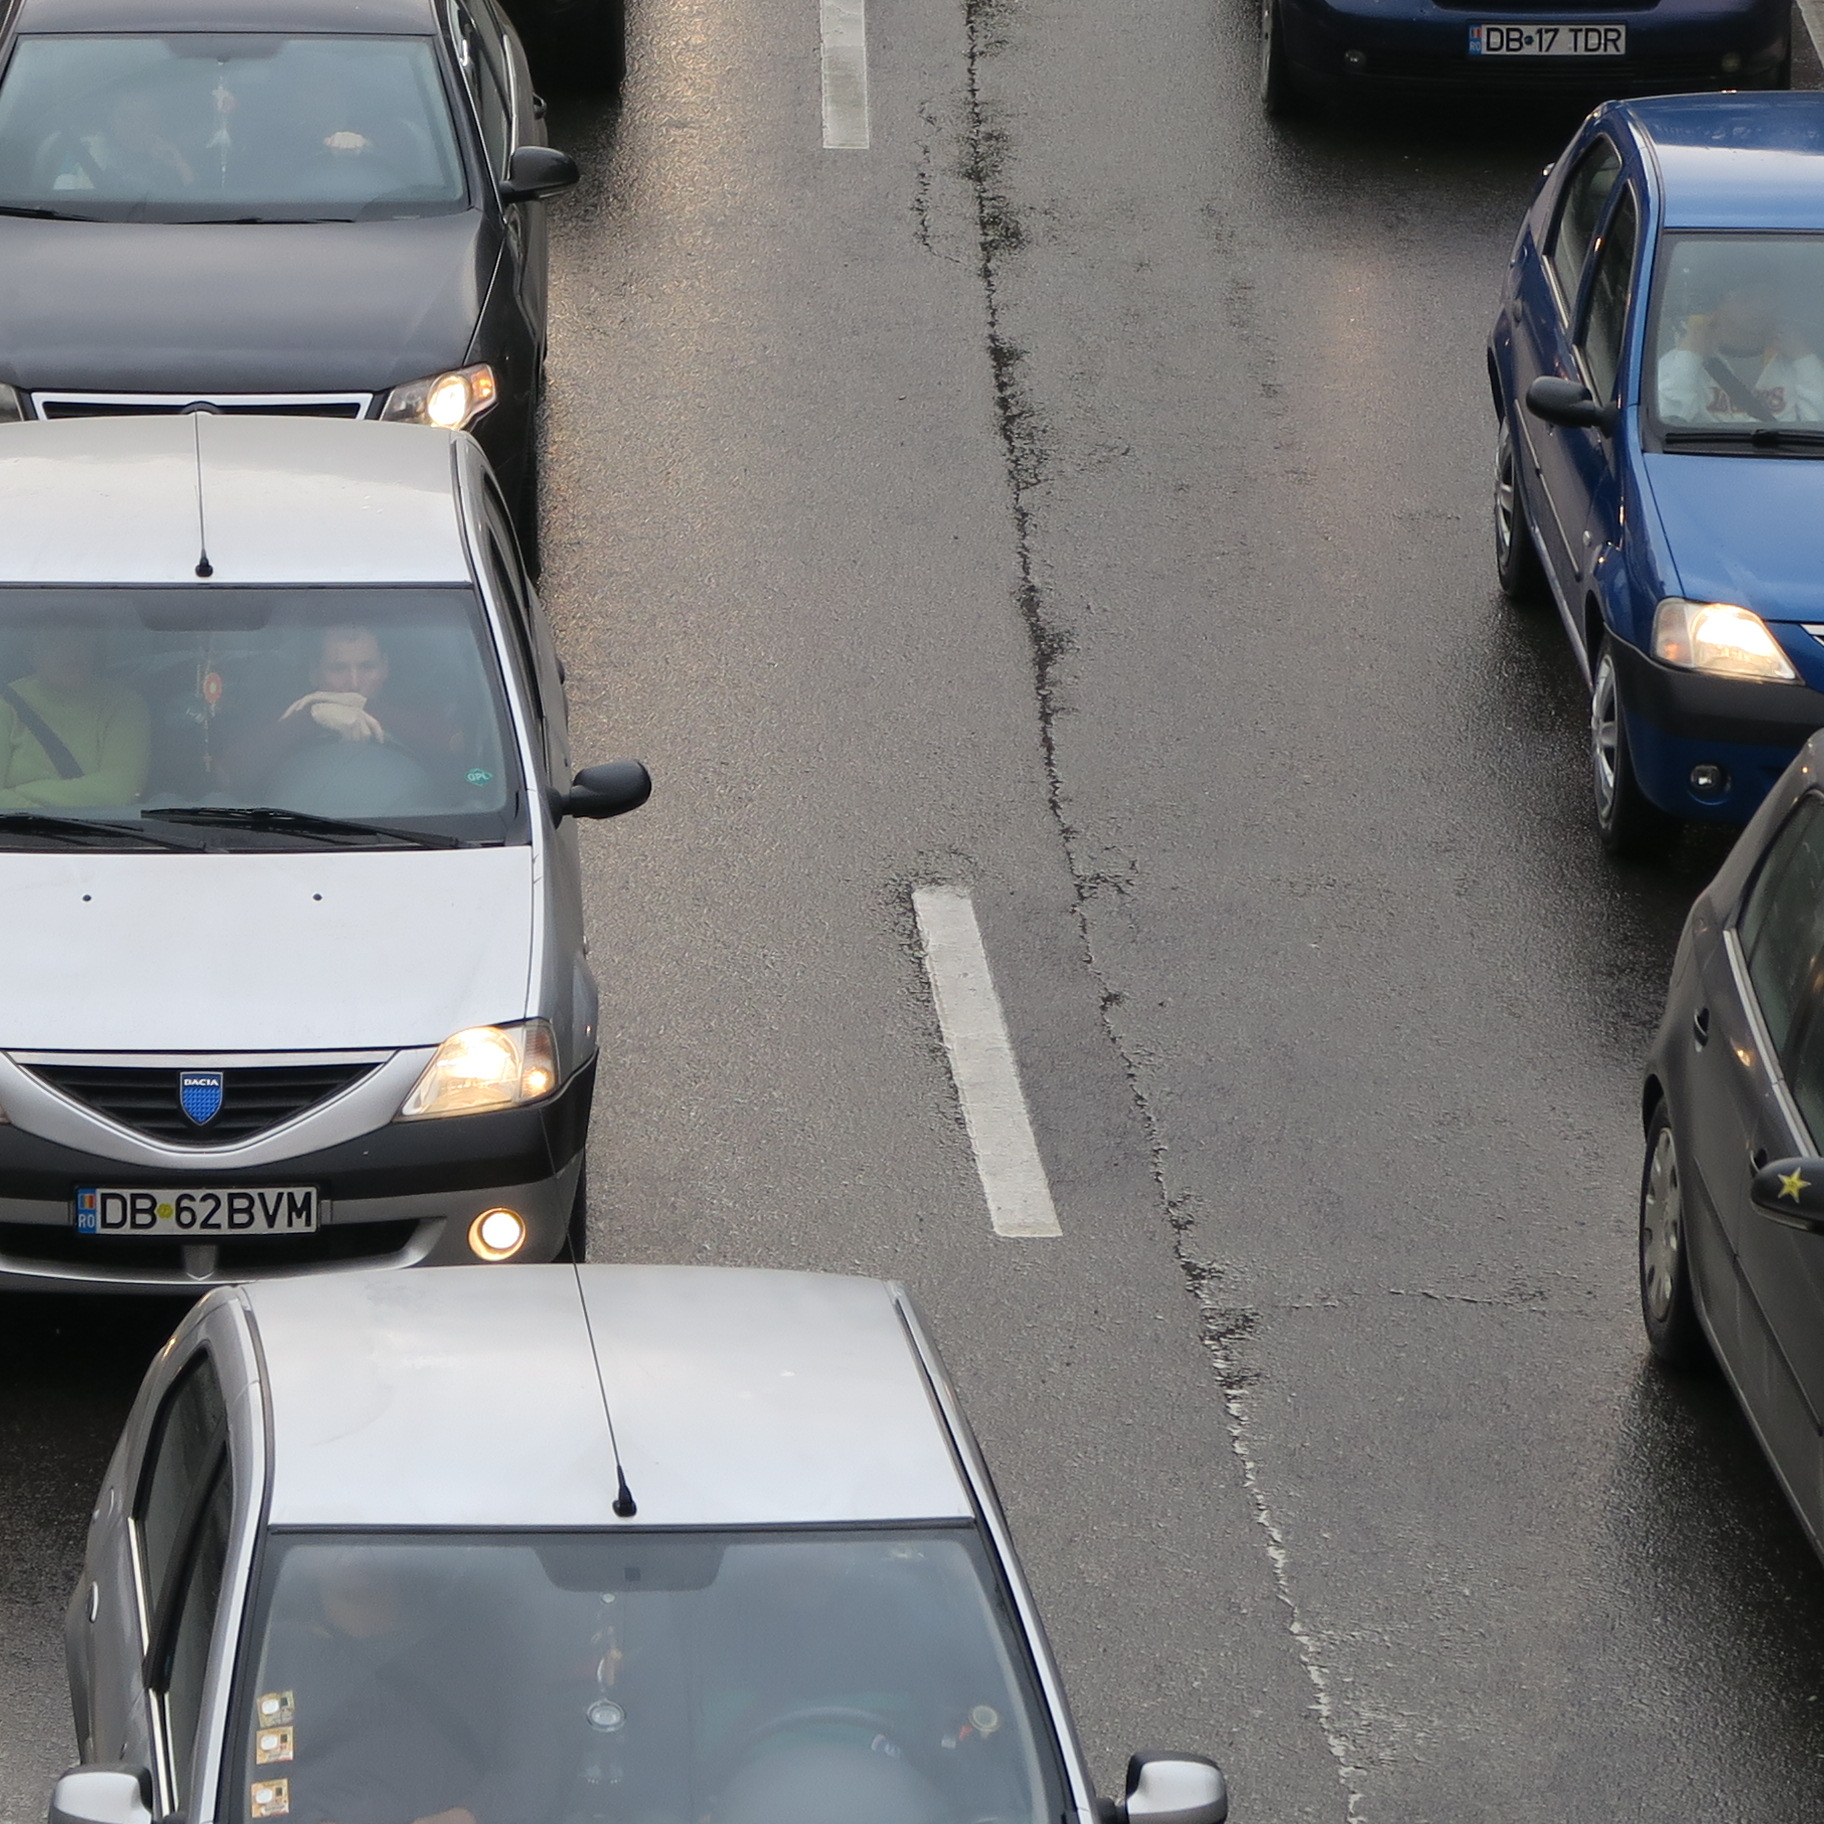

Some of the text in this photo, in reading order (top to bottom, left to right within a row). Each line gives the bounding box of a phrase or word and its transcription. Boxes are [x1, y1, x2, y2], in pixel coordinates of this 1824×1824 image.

[1485, 27, 1525, 53] DB
[1534, 27, 1560, 53] 17
[1568, 27, 1622, 53] TDR
[184, 1078, 219, 1086] DACIA
[78, 1214, 95, 1230] RO
[100, 1192, 158, 1231] DB
